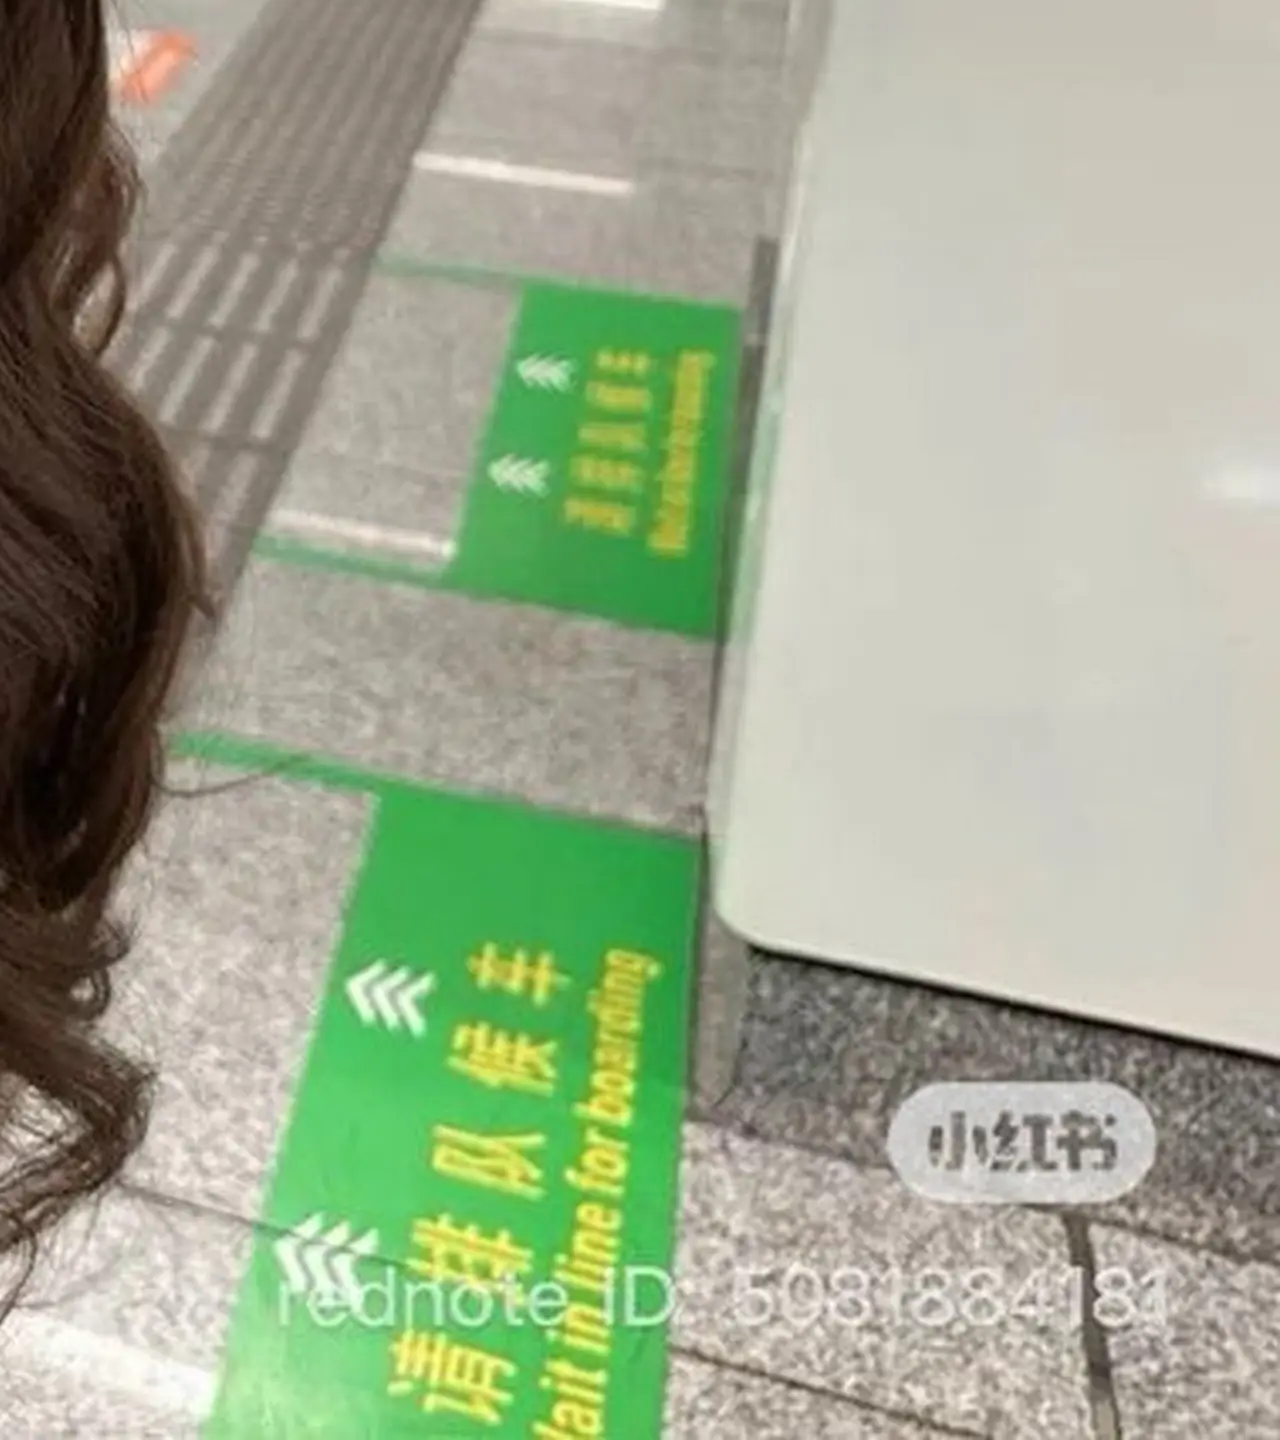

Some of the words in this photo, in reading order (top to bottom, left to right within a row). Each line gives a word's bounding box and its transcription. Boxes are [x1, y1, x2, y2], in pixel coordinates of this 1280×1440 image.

[572, 947, 662, 1128] boarding
[388, 941, 572, 1426] 请排队候车
[564, 1126, 630, 1197] for
[552, 1202, 623, 1291] line
[546, 1302, 611, 1356] in
[532, 1357, 608, 1440] ait
